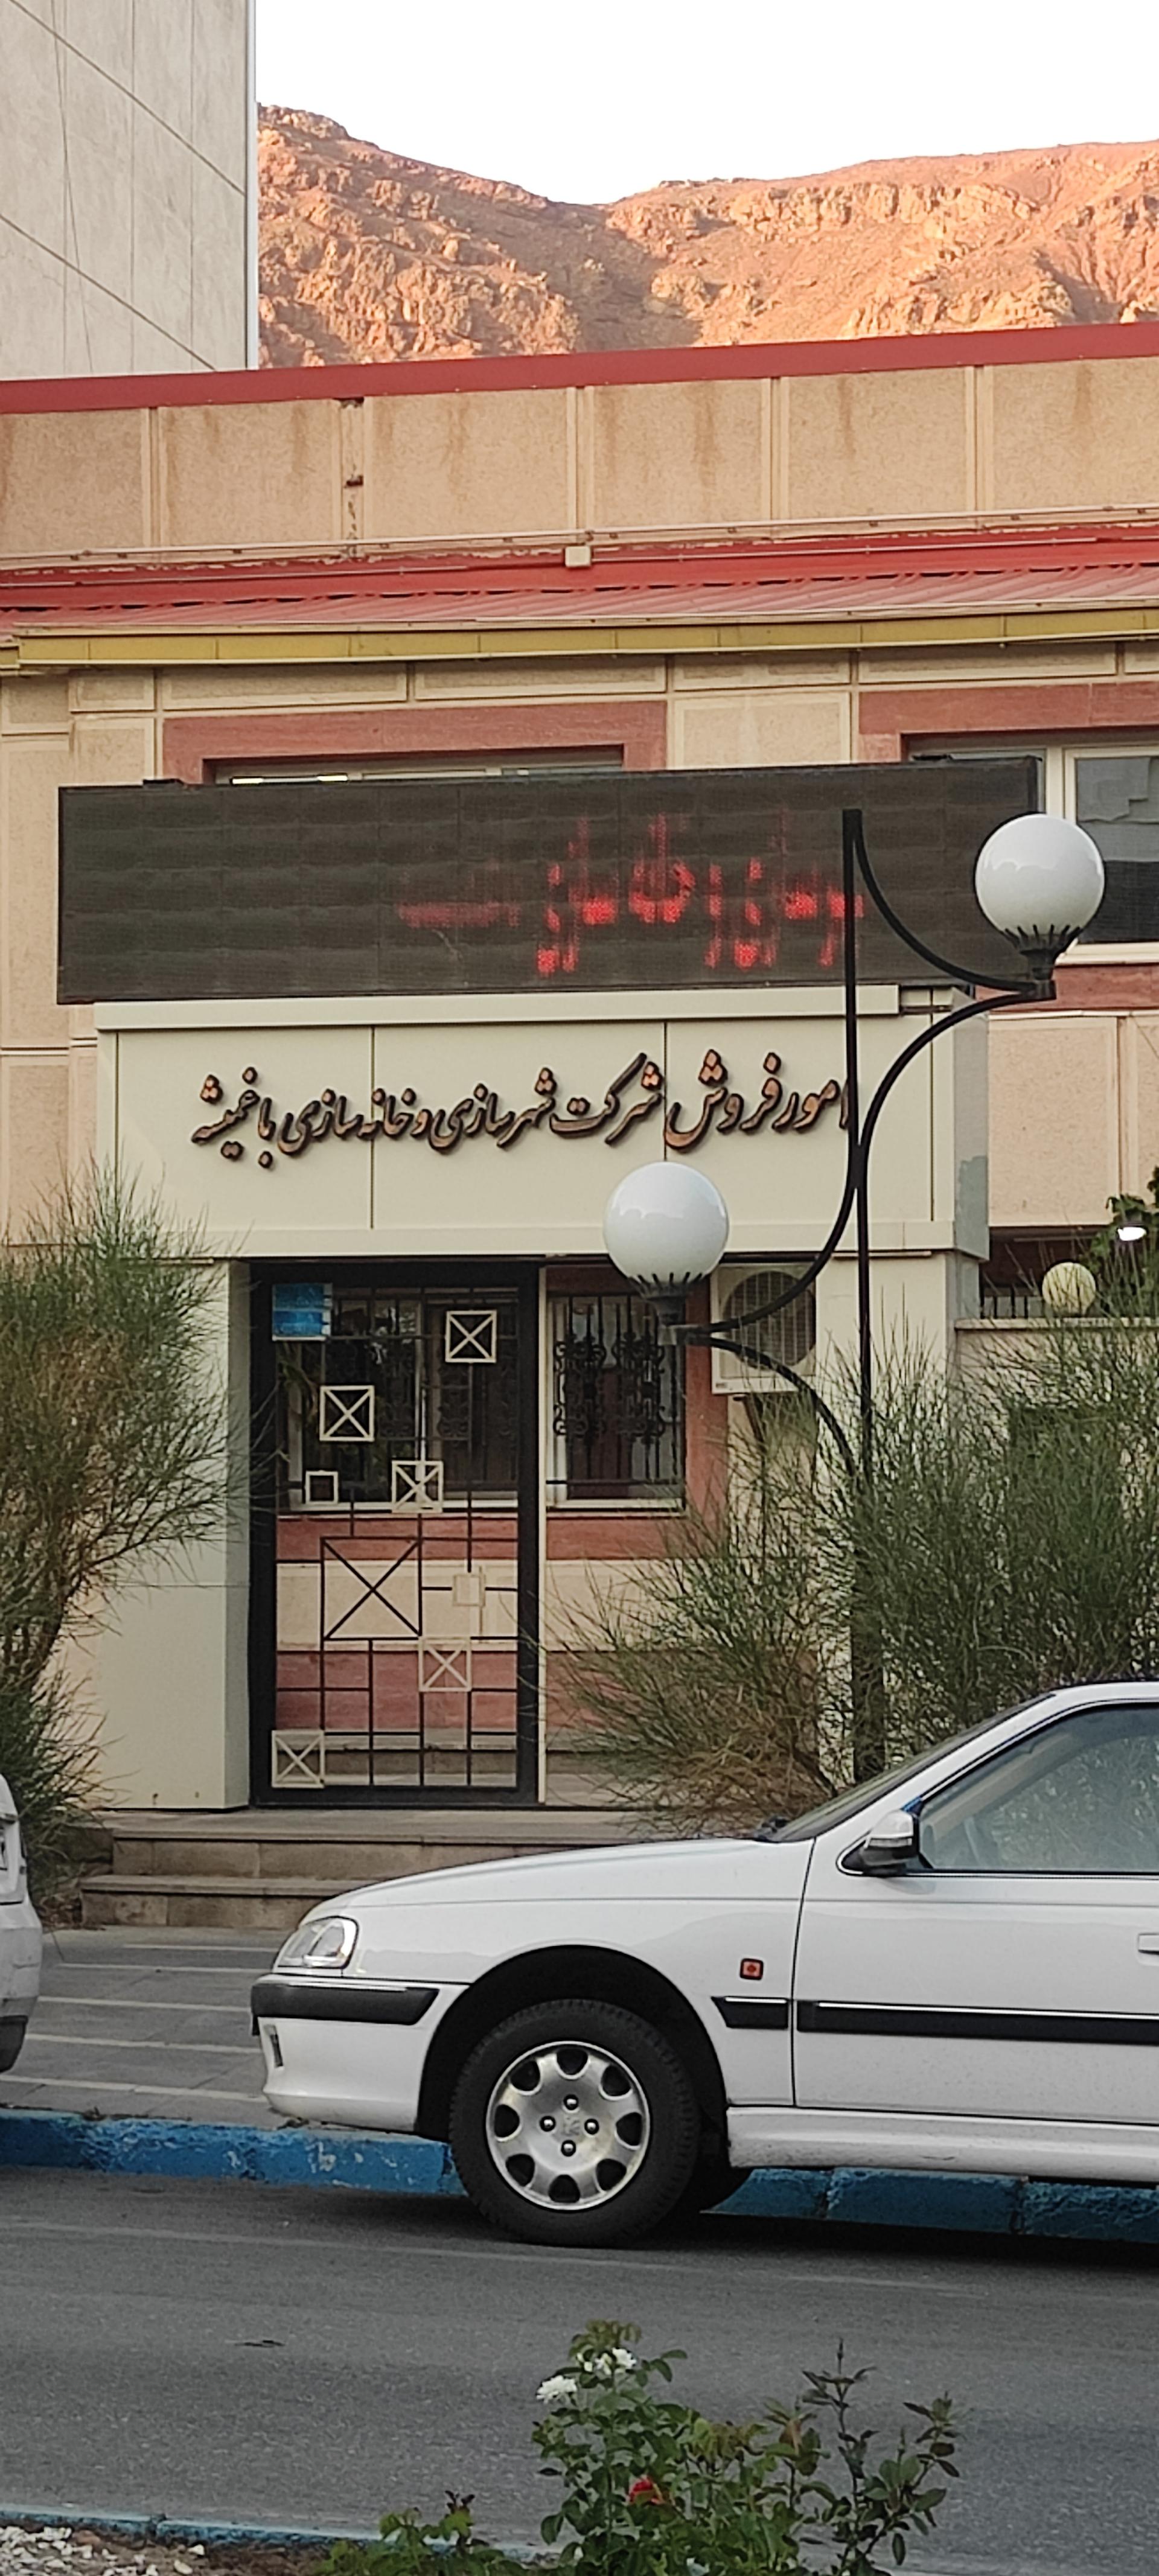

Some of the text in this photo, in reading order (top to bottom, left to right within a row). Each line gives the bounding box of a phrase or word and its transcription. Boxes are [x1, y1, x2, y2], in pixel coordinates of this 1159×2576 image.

[549, 1052, 664, 1146] شرکت
[664, 1049, 783, 1153] فروش
[771, 1079, 849, 1133] امور
